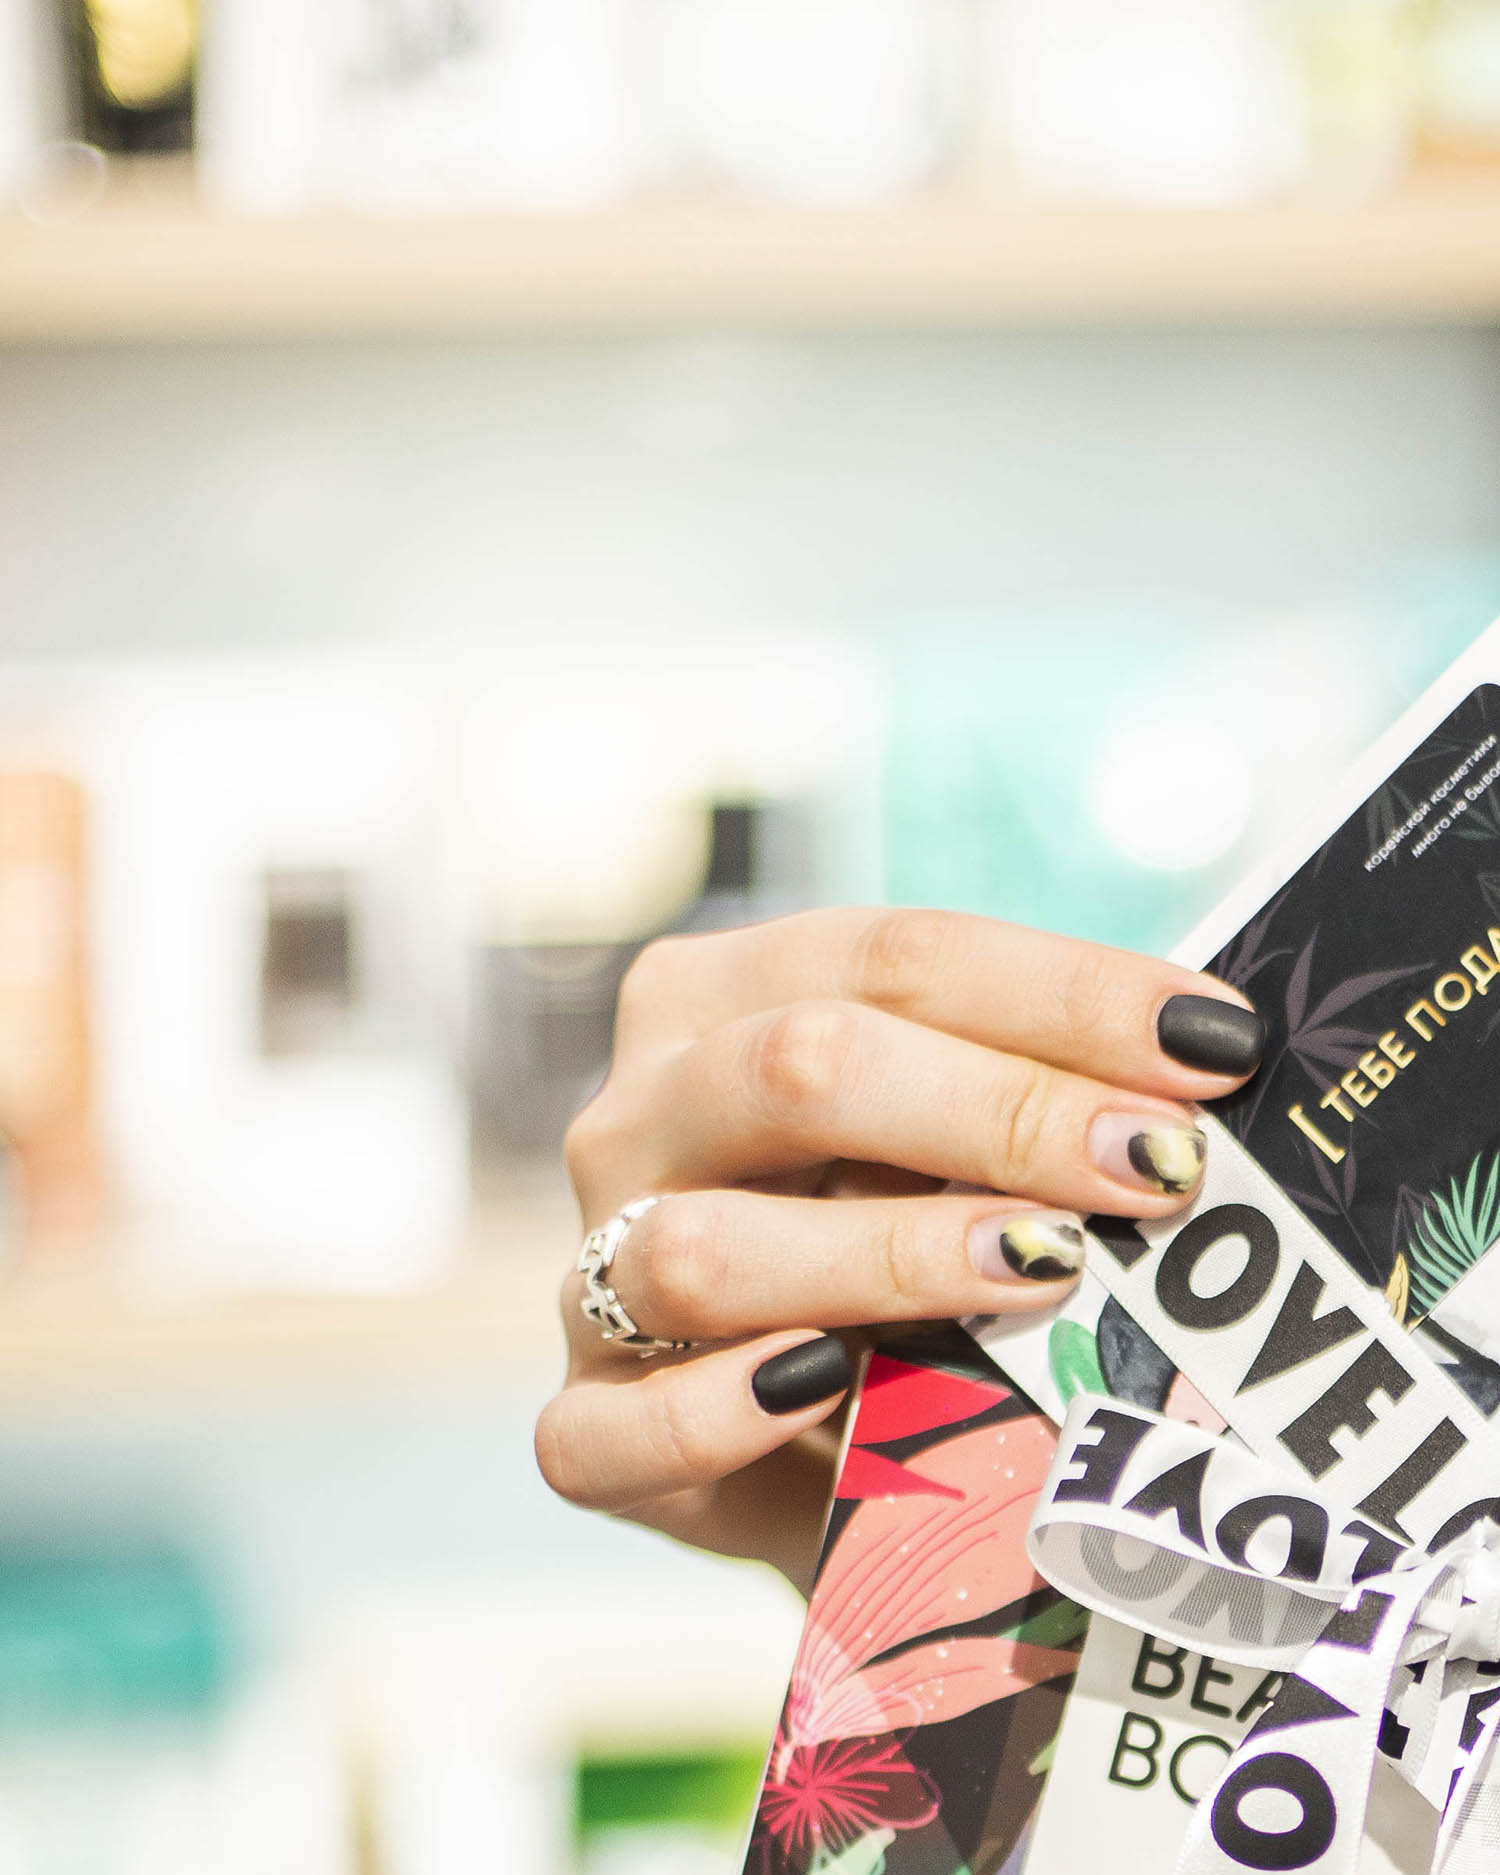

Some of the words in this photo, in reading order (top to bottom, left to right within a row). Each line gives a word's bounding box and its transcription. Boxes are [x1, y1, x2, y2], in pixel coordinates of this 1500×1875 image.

[1364, 801, 1431, 872] корейской
[1430, 734, 1497, 804] косметики
[1411, 818, 1450, 859] много
[1449, 801, 1468, 819] не
[1108, 1711, 1236, 1808] BO
